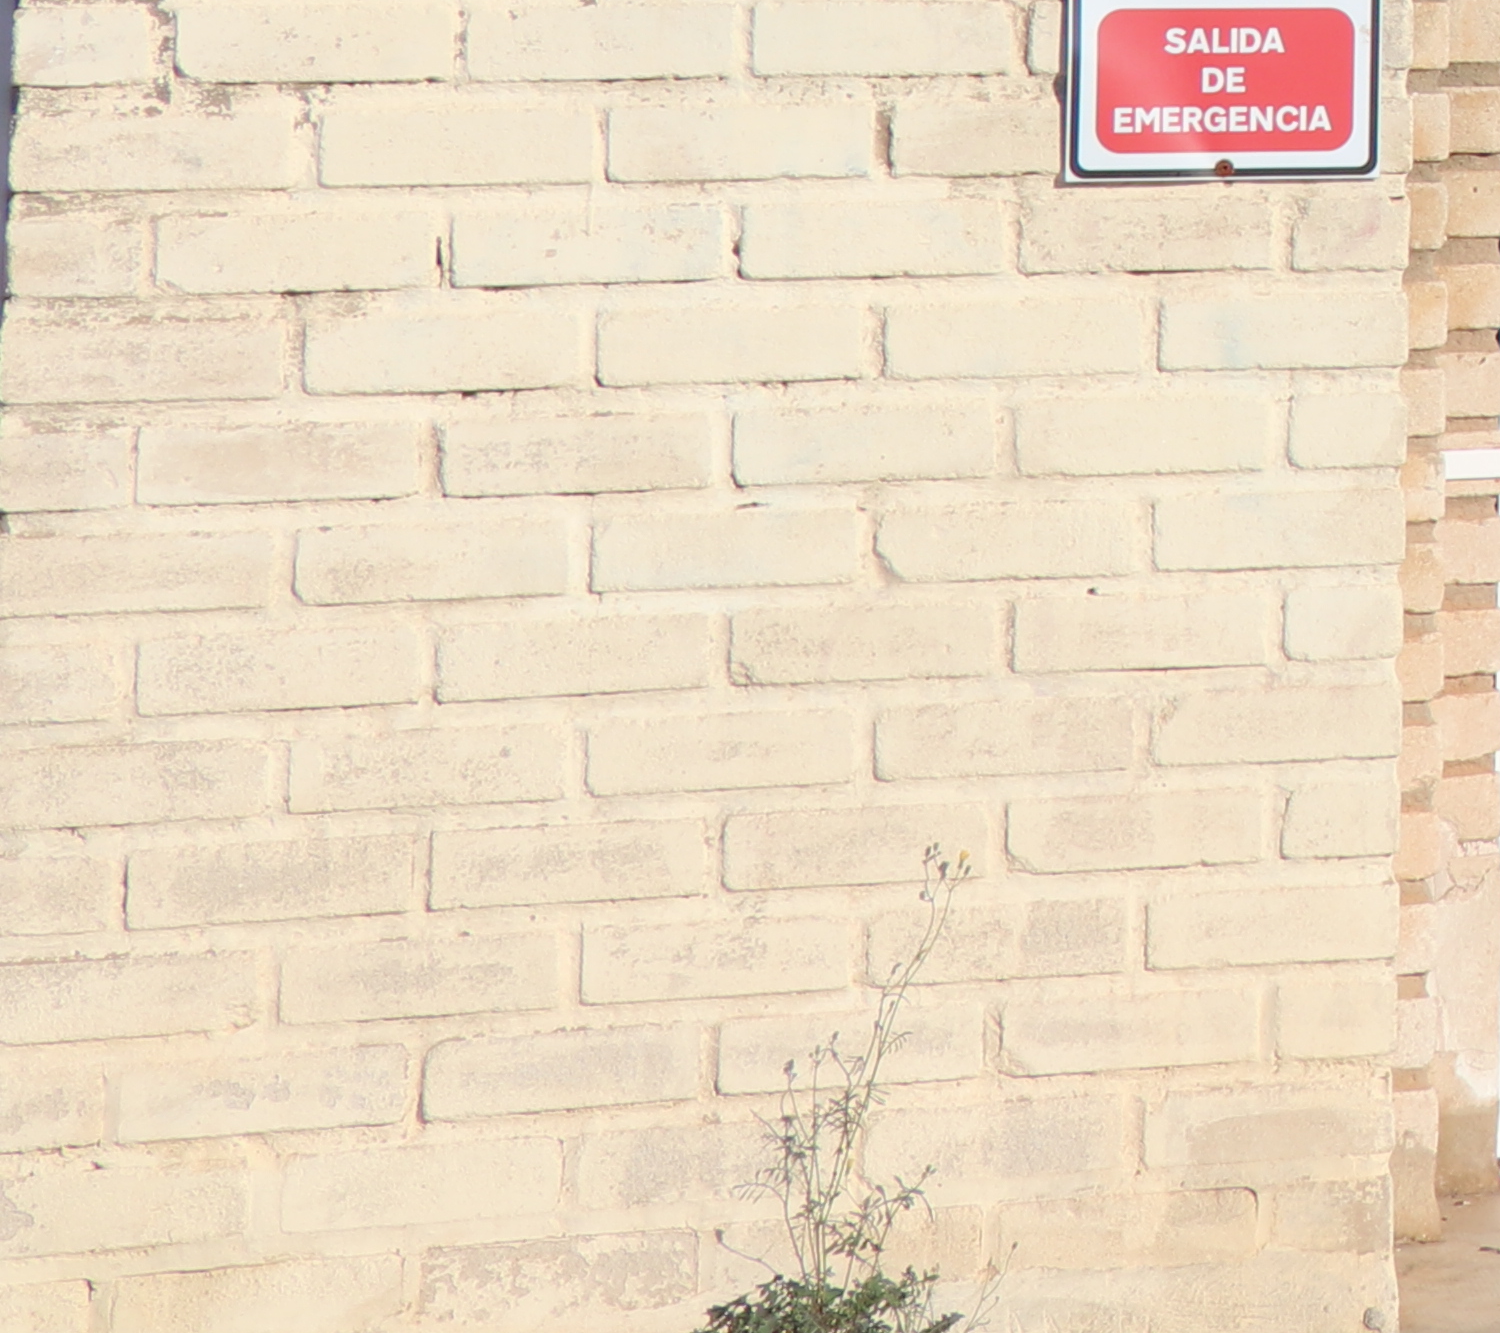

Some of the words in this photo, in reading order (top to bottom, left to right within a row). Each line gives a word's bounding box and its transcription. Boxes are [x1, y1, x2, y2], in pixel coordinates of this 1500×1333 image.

[1164, 27, 1285, 54] SALIDA
[1201, 66, 1247, 93] DE
[1113, 105, 1333, 133] EMERGENCIA
